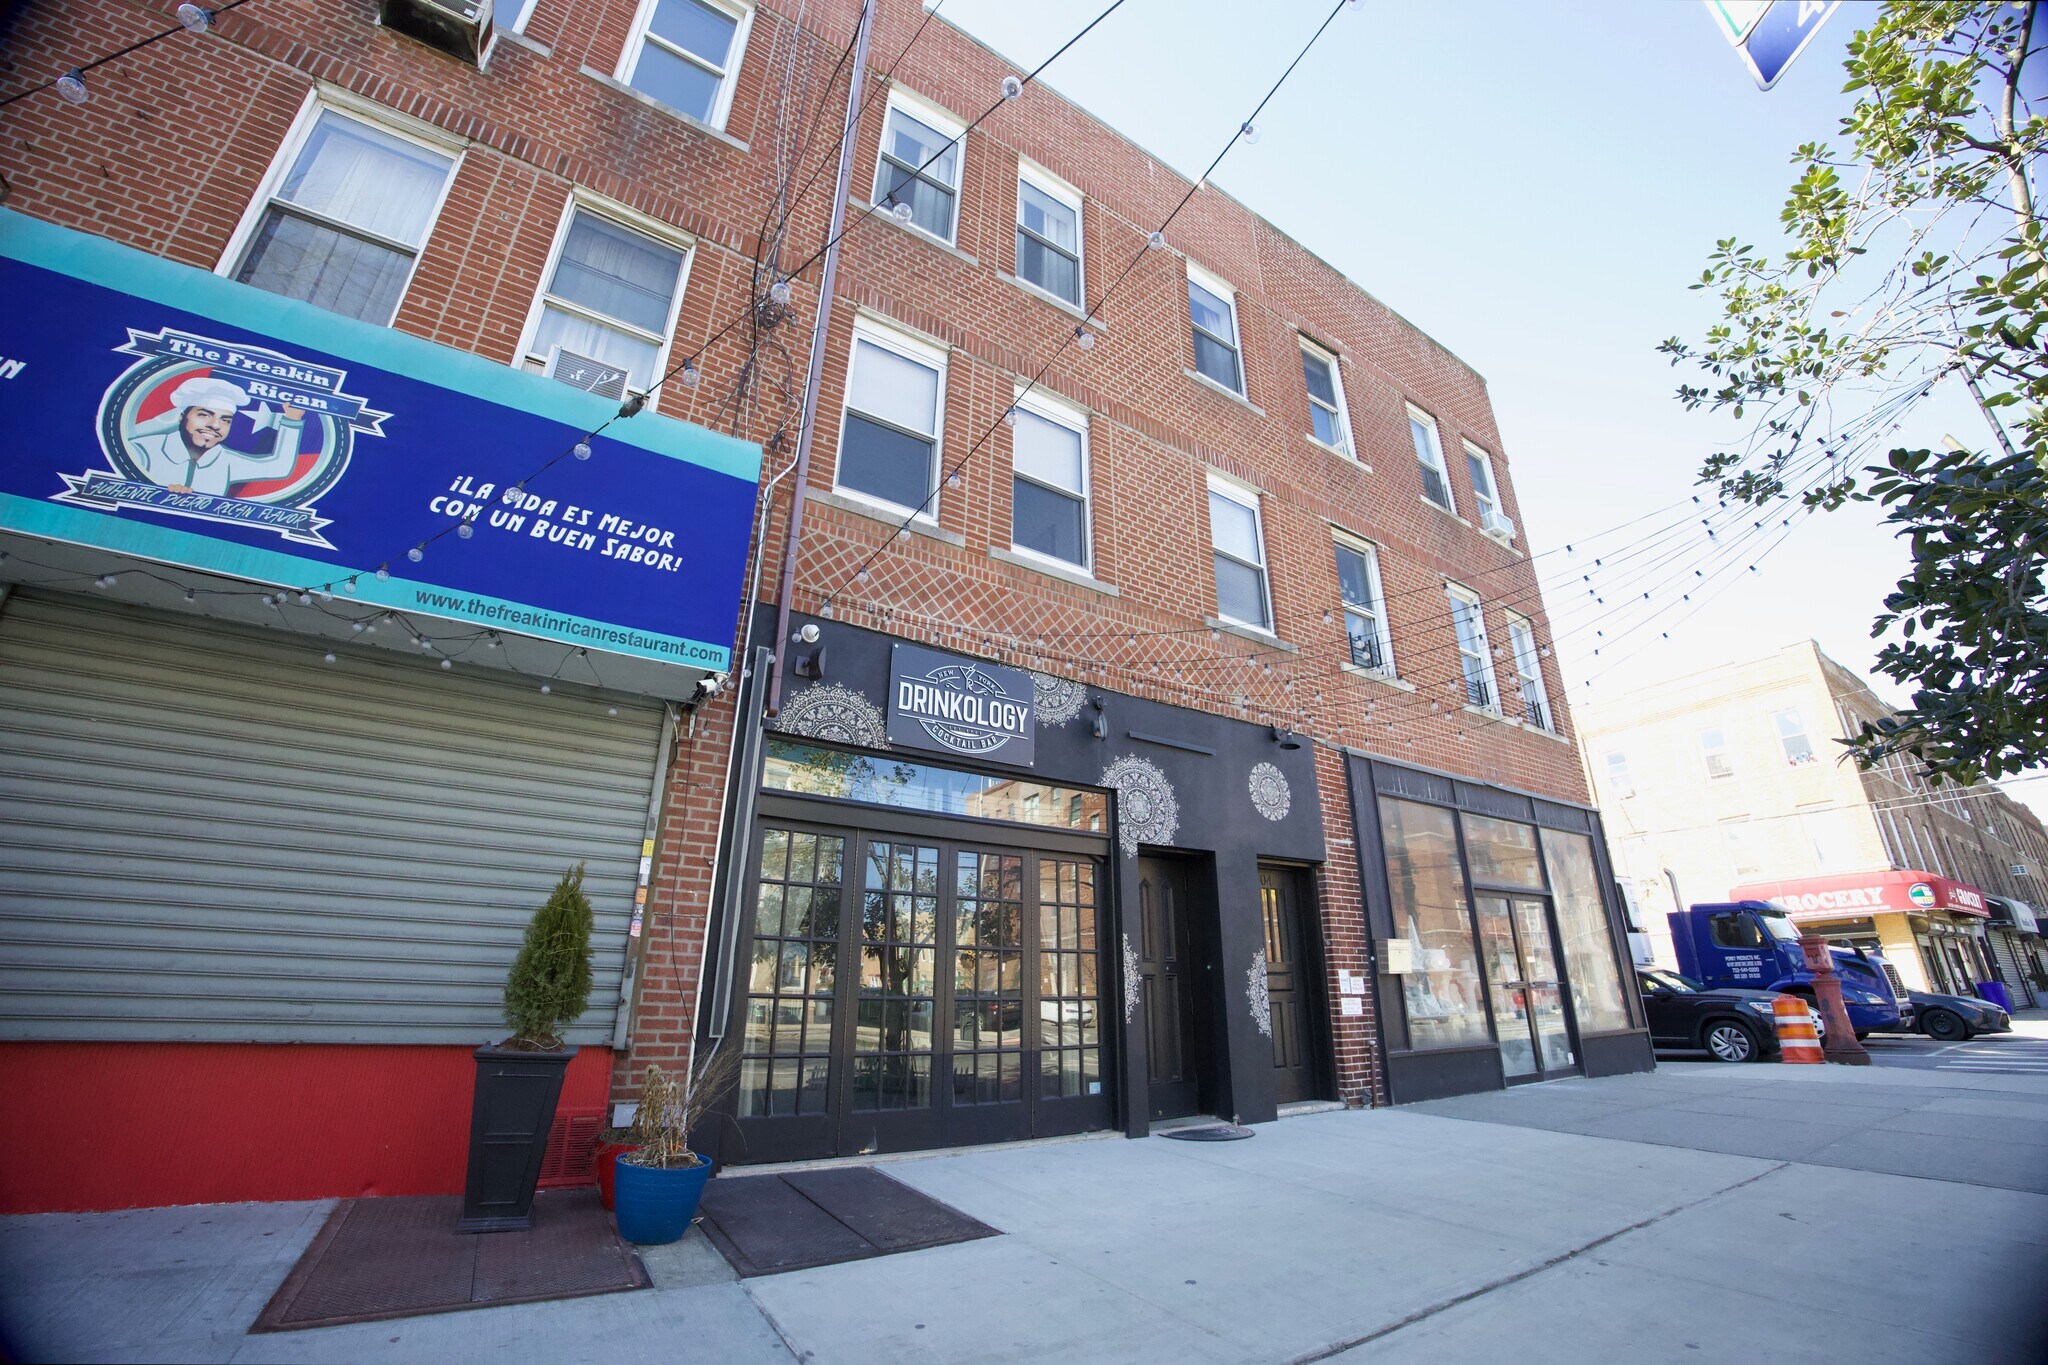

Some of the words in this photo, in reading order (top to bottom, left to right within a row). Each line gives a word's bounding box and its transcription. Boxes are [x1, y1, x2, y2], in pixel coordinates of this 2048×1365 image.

[169, 339, 221, 361] The
[226, 352, 330, 387] Freakin
[248, 381, 328, 411] Rican
[90, 481, 156, 503] AUTHENTIC
[214, 503, 254, 517] RICAN
[259, 508, 309, 529] FLAVOR
[562, 506, 594, 526] ES
[598, 514, 675, 549] MEJOR
[429, 496, 484, 522] CON
[489, 510, 526, 532] UN
[530, 519, 596, 551] BUEN
[601, 539, 683, 572] SABOR!
[416, 590, 723, 663] www.thefreakinricanrestaurant.com
[938, 670, 954, 679] NEW
[978, 675, 996, 690] YORK
[898, 682, 1029, 733] DRINKOLOGY
[932, 725, 976, 749] COCKTAIL
[980, 736, 998, 748] BAR
